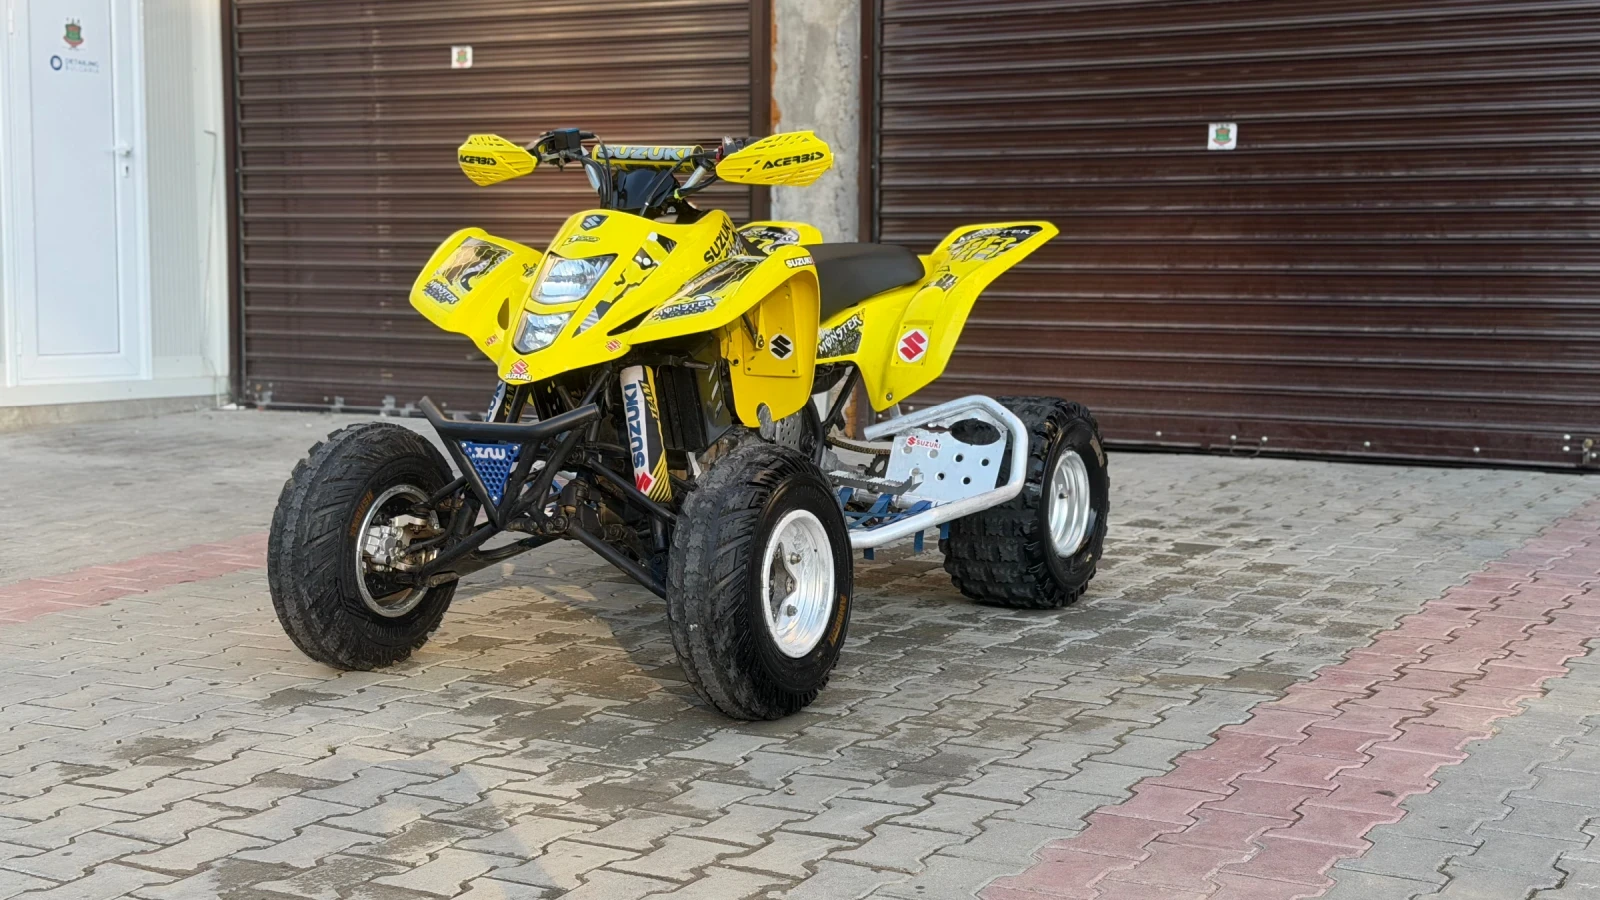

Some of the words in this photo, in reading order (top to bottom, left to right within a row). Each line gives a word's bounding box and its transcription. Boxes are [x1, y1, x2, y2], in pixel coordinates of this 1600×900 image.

[460, 154, 497, 166] ACERBIS
[597, 146, 692, 161] SUZUKI
[761, 151, 825, 170] ACERBIS
[703, 215, 732, 264] SUZUKI
[818, 315, 862, 354] MONSTER
[505, 373, 532, 381] SUZUKI
[641, 382, 658, 419] TEAM
[624, 383, 646, 469] SUZUKI
[916, 440, 942, 449] SUZUKI
